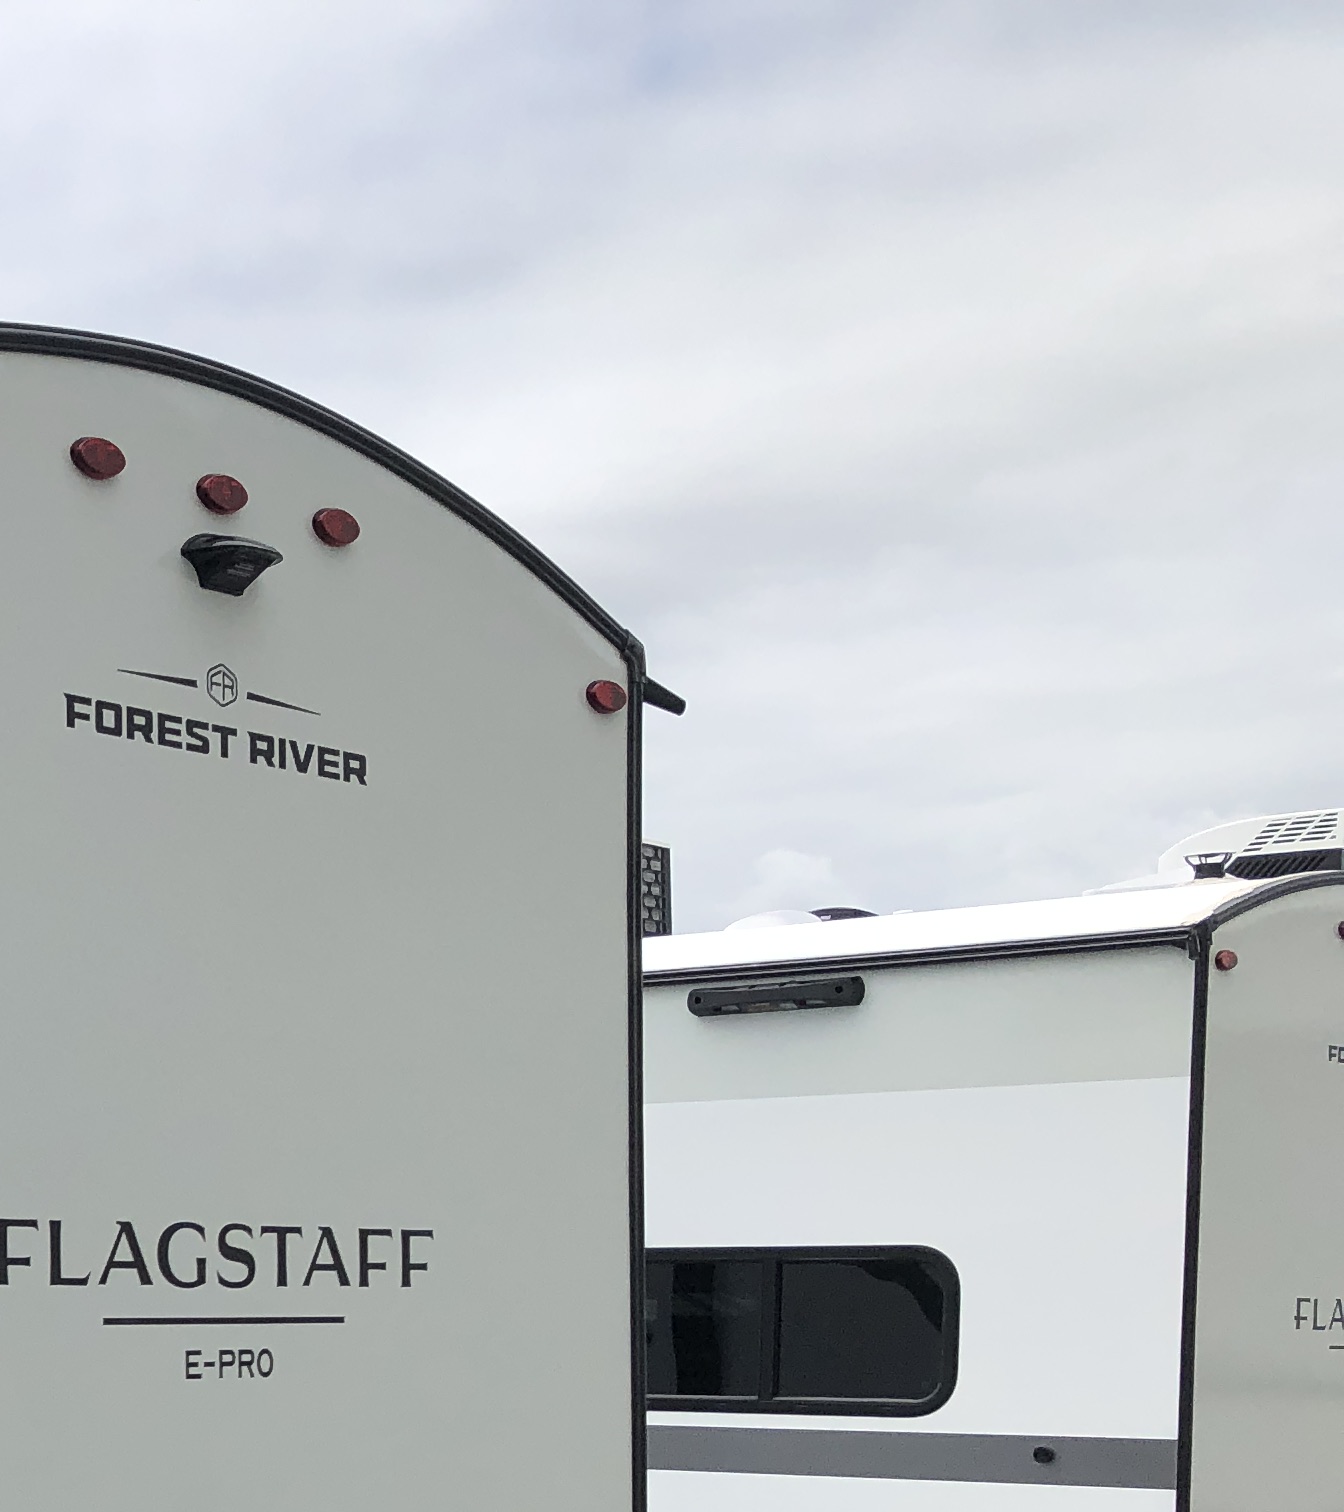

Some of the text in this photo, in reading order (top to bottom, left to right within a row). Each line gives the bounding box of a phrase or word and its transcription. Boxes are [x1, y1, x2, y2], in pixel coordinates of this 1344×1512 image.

[63, 692, 368, 786] FOREST RIVER
[184, 1348, 275, 1380] E-PRO
